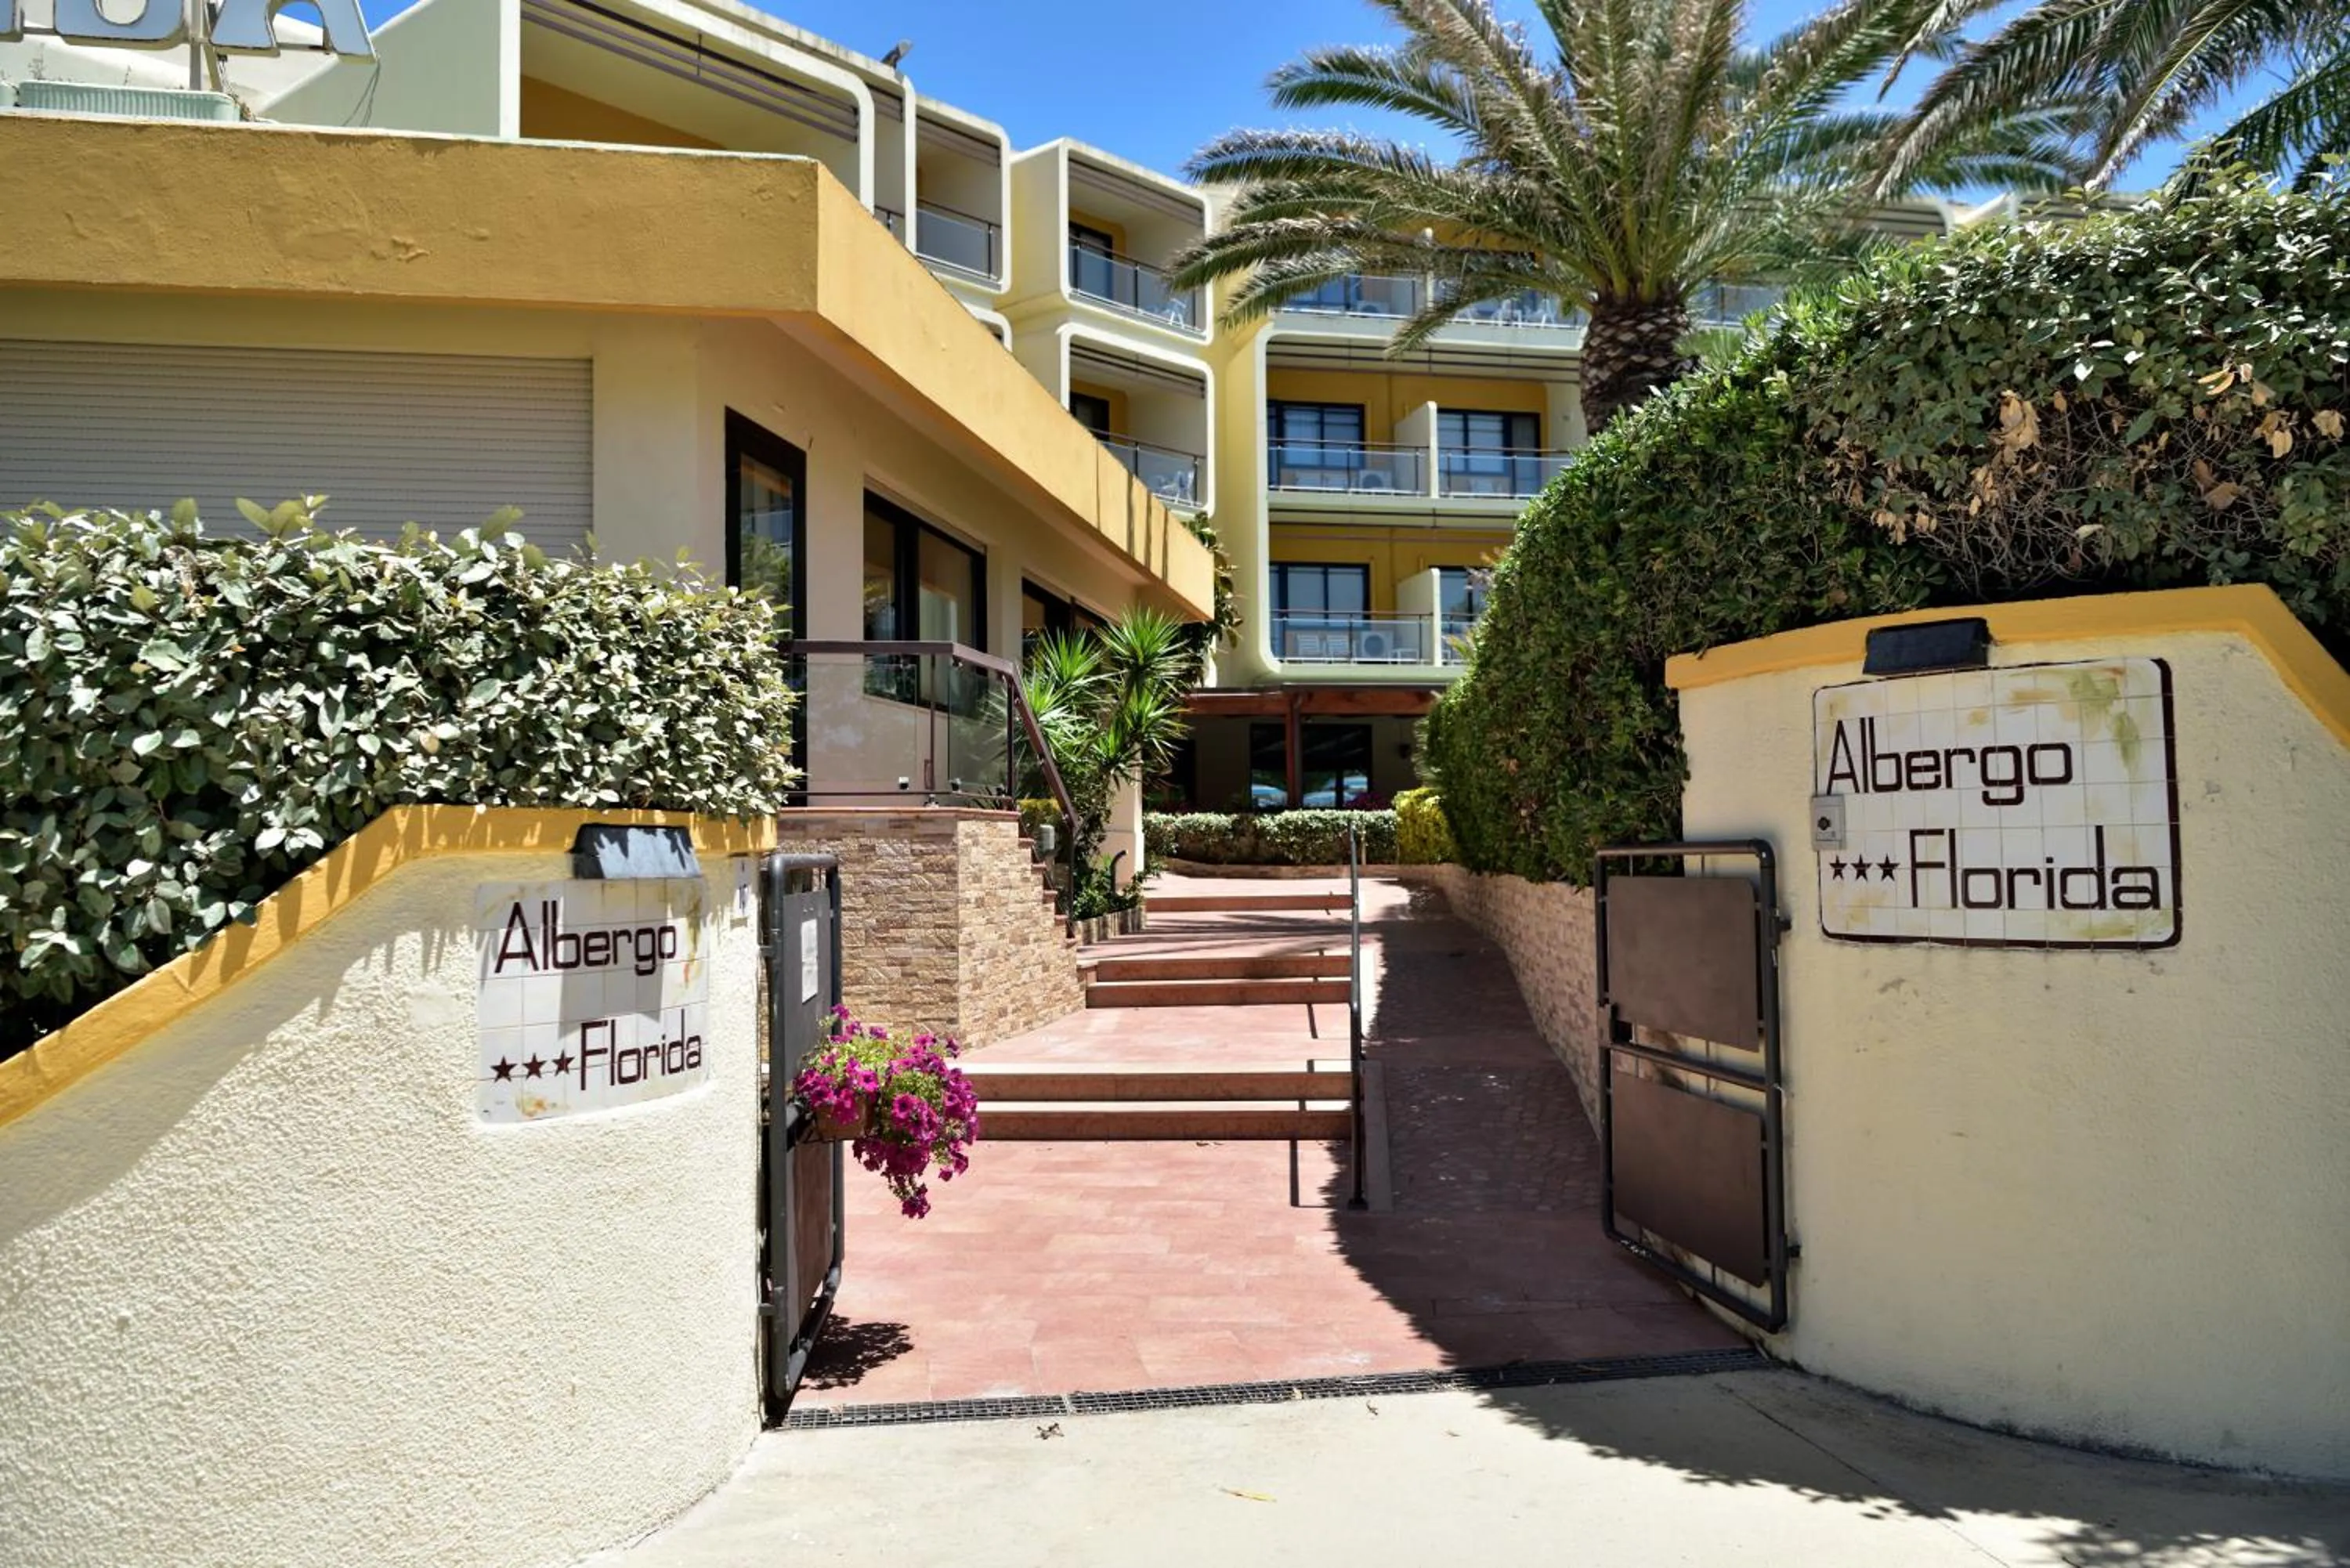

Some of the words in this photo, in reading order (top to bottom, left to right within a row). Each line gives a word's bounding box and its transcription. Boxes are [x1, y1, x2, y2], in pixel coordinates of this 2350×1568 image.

[1826, 717, 2073, 806] Albergo
[1909, 825, 2160, 910] Florida
[494, 900, 676, 977] Albergo
[580, 1009, 702, 1091] Florida
